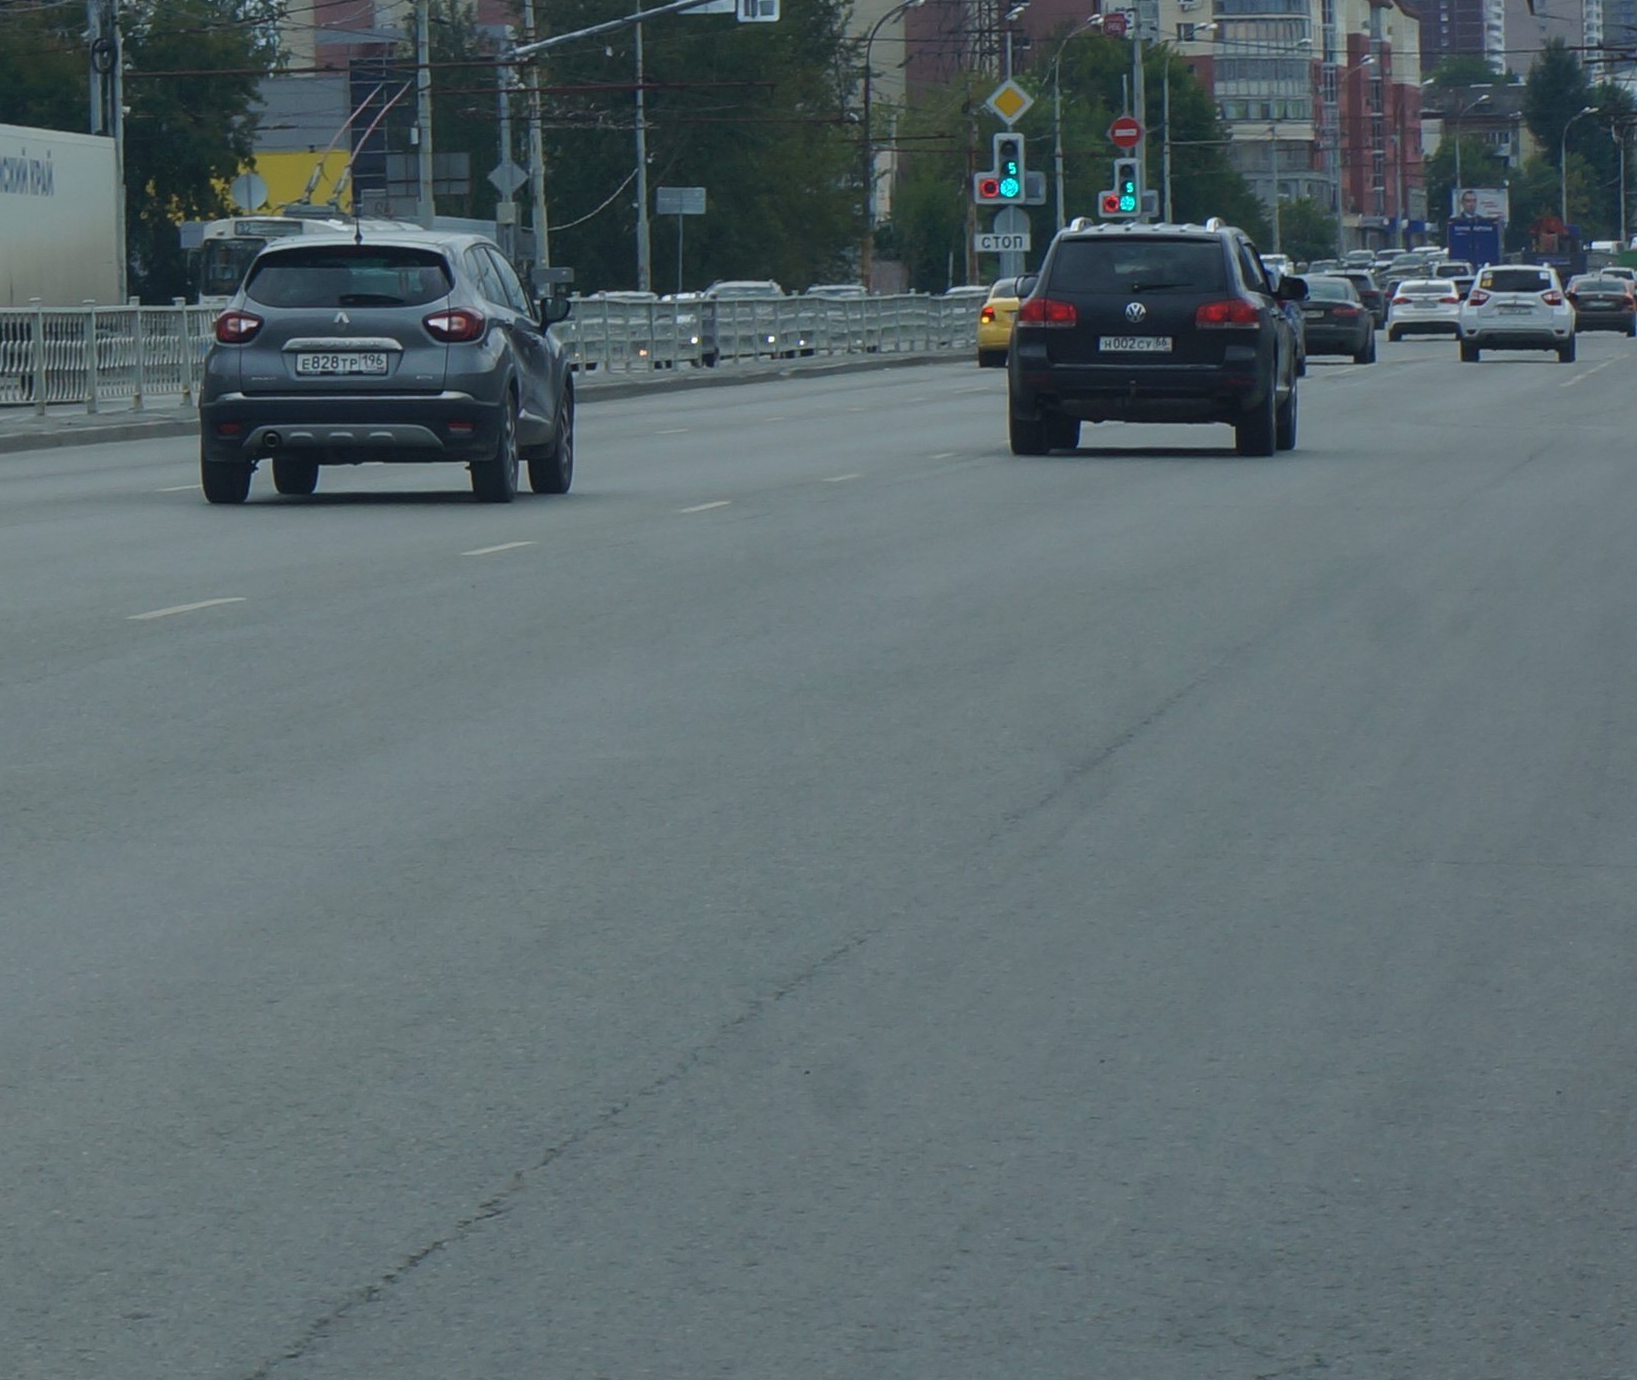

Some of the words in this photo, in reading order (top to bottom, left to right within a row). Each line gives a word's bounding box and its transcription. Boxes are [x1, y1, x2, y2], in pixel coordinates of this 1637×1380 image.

[30, 149, 54, 196] КРАЙ
[1009, 163, 1016, 174] 5
[1126, 183, 1133, 192] 5
[982, 236, 1023, 248] СТОП
[302, 356, 358, 370] Е828ТР
[362, 355, 384, 366] 196
